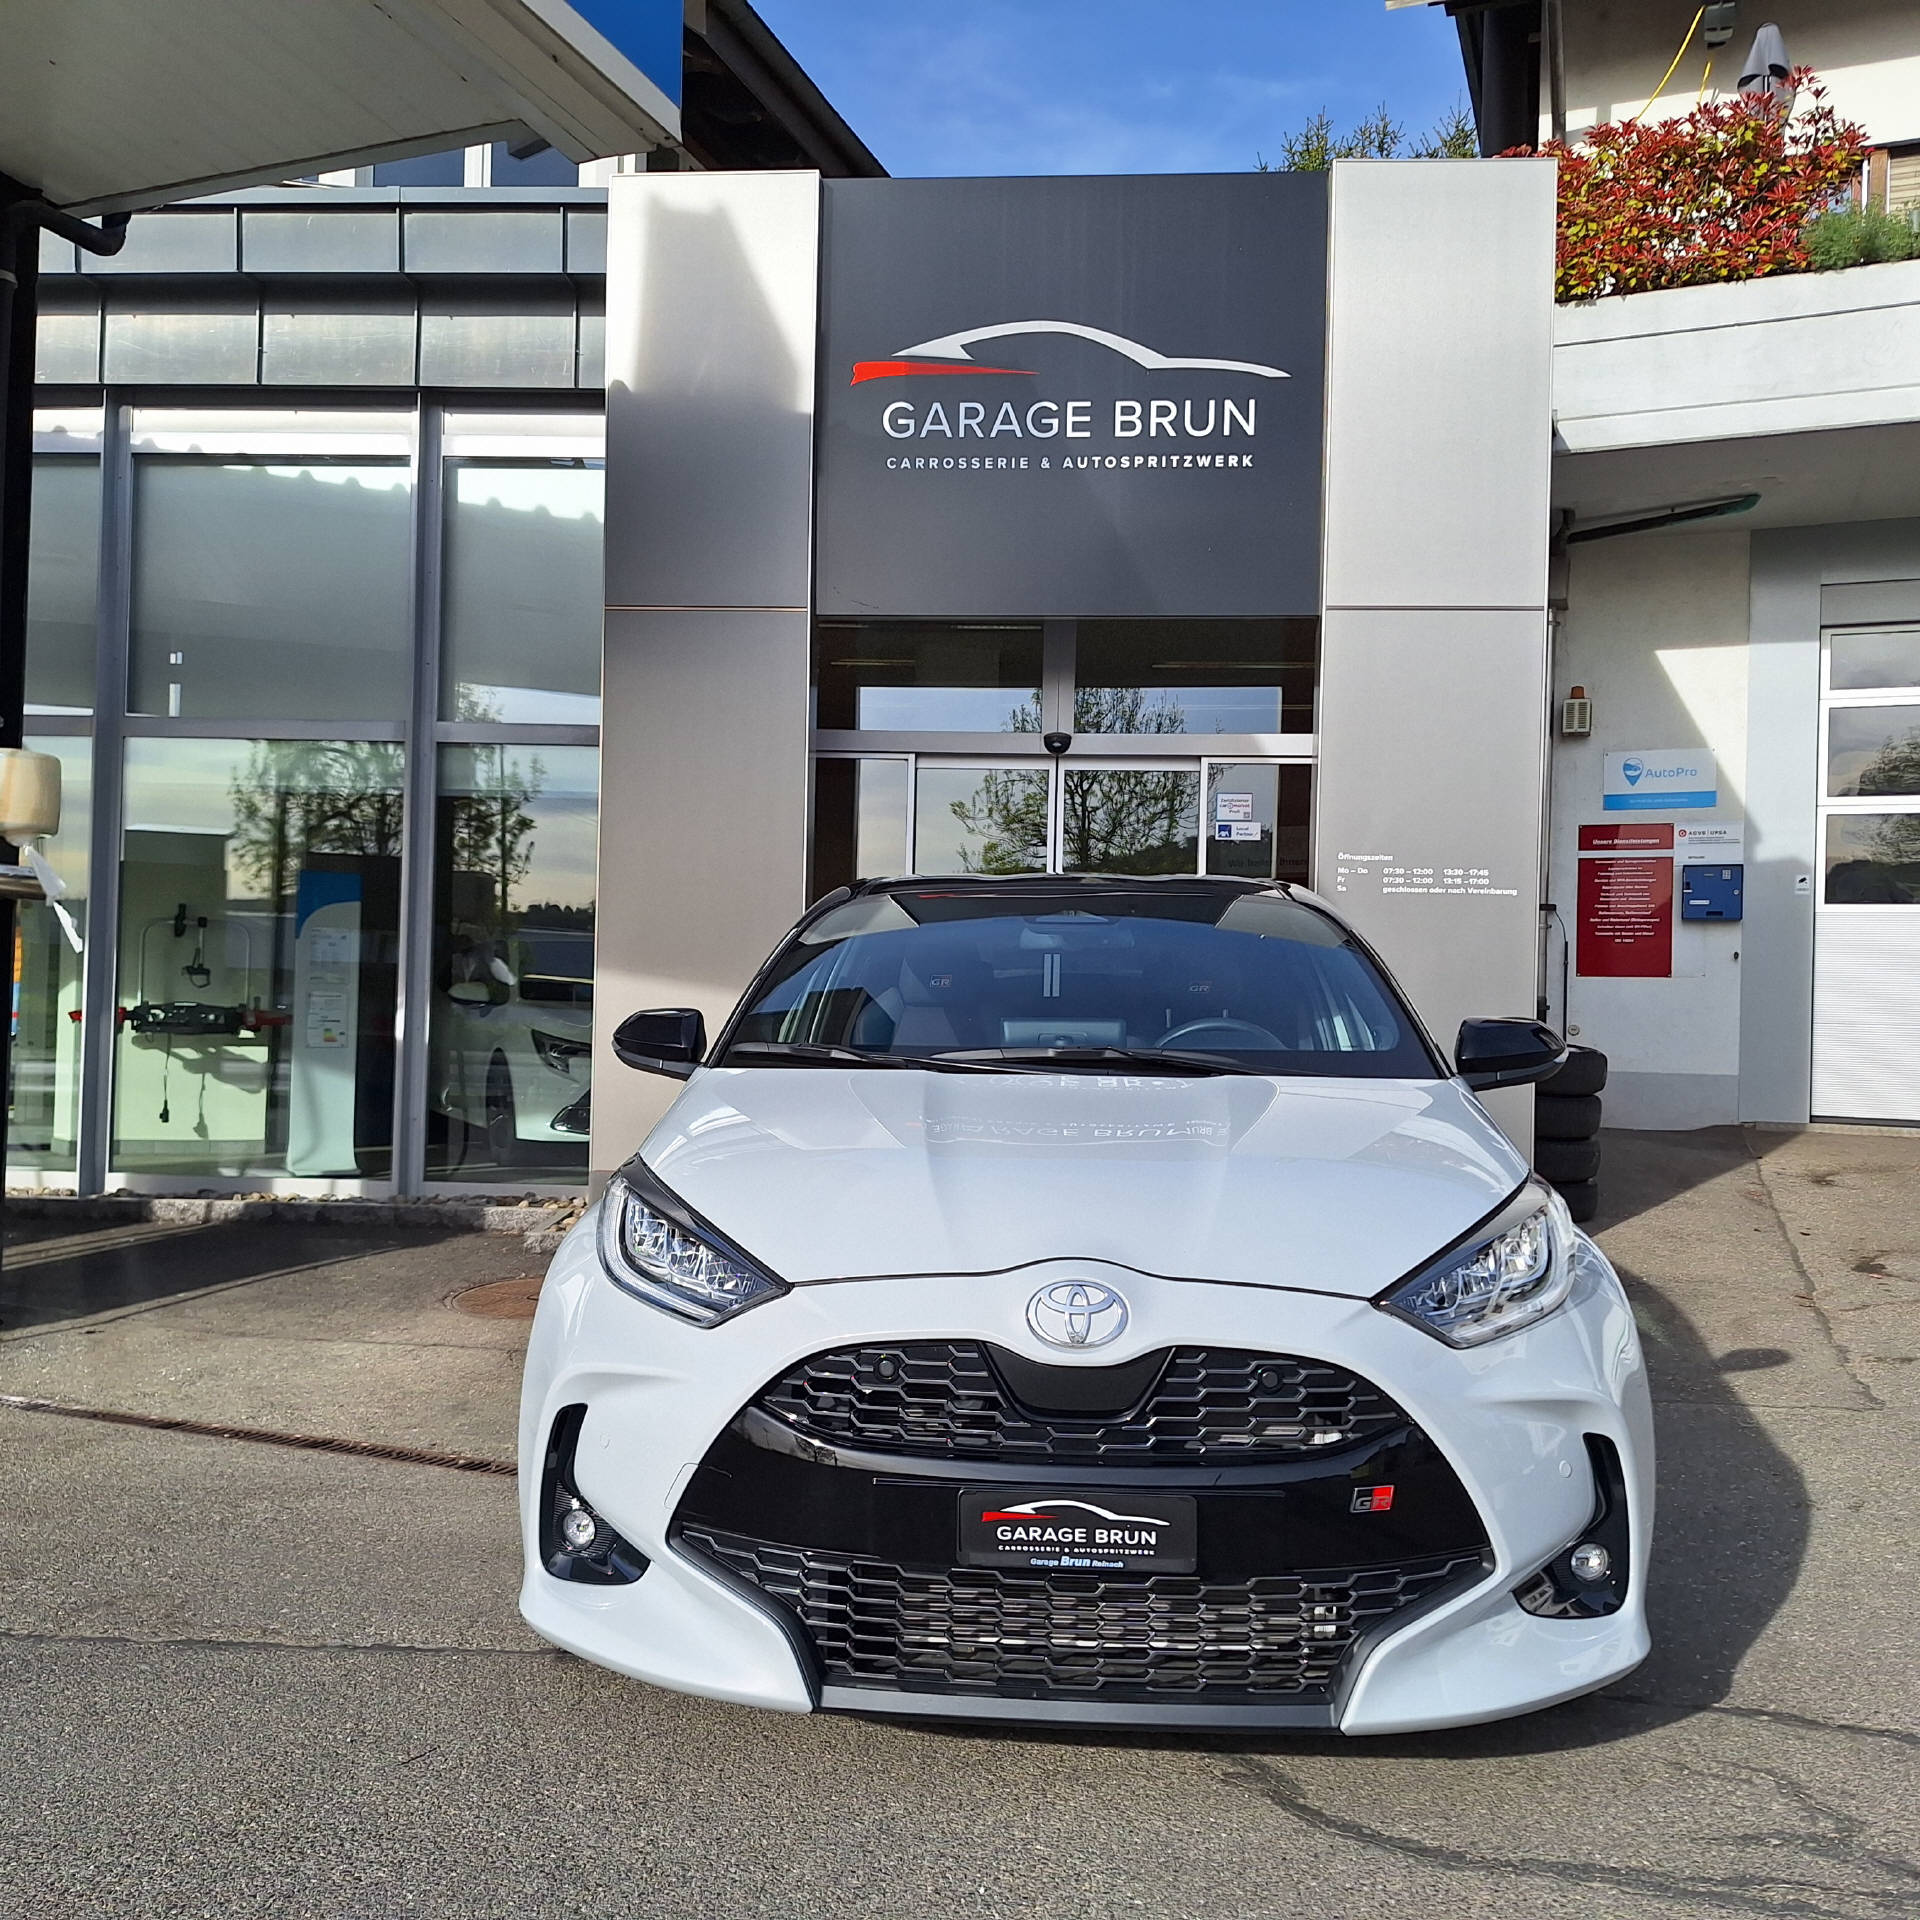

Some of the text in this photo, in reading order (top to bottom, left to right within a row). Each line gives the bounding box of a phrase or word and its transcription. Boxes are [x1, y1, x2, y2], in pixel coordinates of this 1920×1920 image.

[882, 399, 1256, 439] GARAGE BRUN
[886, 454, 1255, 470] CARROSSERIE & AUTOSPRITZWERK
[1644, 767, 1697, 778] AutoPro
[1337, 852, 1394, 862] Öffnungszeiten
[1382, 867, 1405, 875] 07:30
[1412, 867, 1434, 875] 12:00
[1382, 886, 1428, 894] geschlossen
[1429, 886, 1446, 894] oder
[1467, 887, 1518, 897] Vereinbarung
[1354, 1496, 1391, 1510] GR
[996, 1526, 1157, 1545] GARAGE BRUN
[998, 1545, 1060, 1553] CARROSSERIE
[1073, 1548, 1155, 1556] AUTOSPRITZWERK
[1030, 1555, 1124, 1568] Garage Brun Reinach
